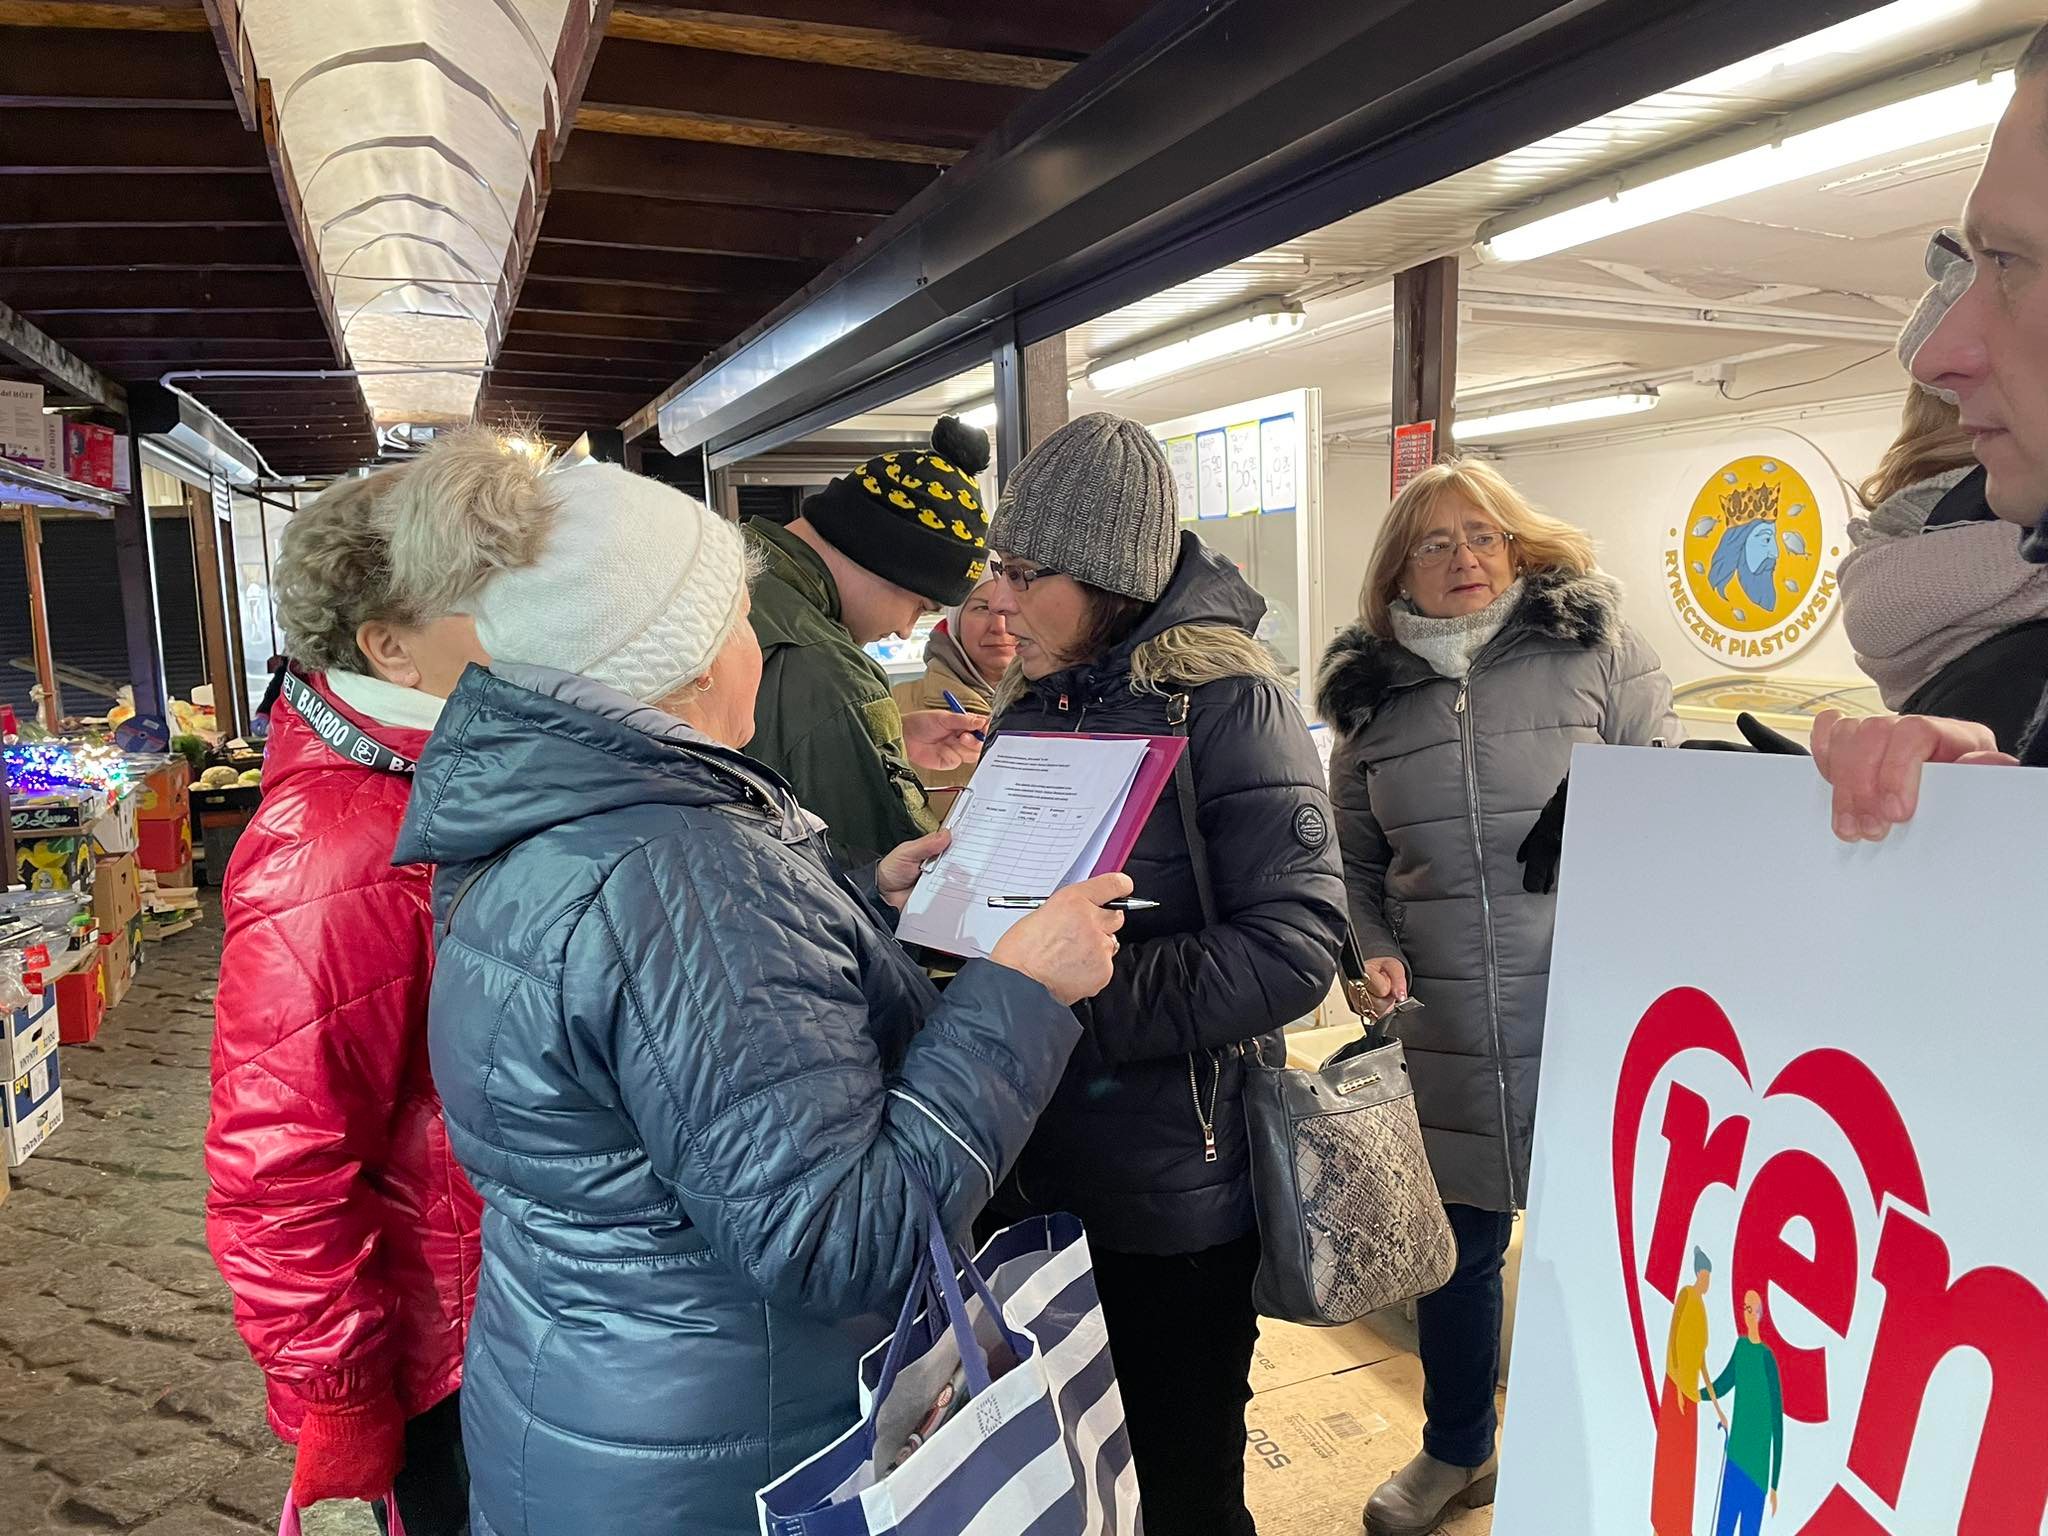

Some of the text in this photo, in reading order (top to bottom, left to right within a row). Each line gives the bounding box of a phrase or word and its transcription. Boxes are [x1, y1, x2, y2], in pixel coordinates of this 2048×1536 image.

[1665, 549, 1838, 659] RYNECZEK PIASTOWSKI
[296, 688, 350, 747] BACARDO
[1247, 1428, 1292, 1470] 500
